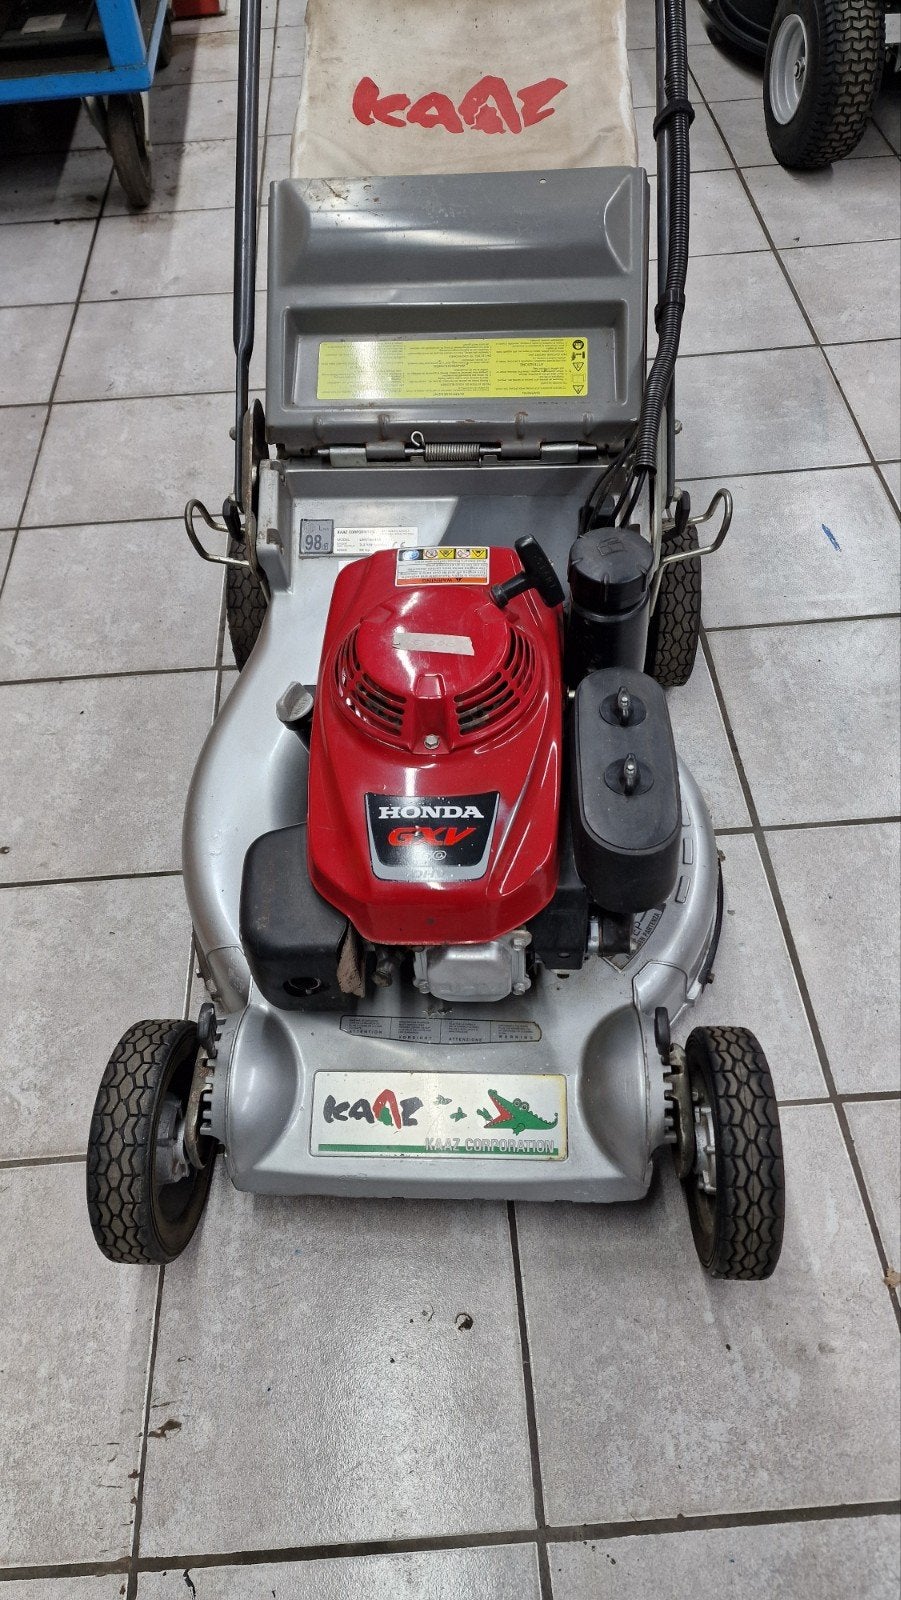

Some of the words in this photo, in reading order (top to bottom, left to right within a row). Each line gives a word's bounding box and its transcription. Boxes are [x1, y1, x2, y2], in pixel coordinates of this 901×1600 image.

[305, 534, 321, 550] 98
[378, 806, 484, 819] HONDA
[388, 826, 477, 846] GXV
[323, 1089, 424, 1129] KAAZ
[425, 1138, 459, 1152] KAAZ
[465, 1138, 555, 1154] CORPORATION
